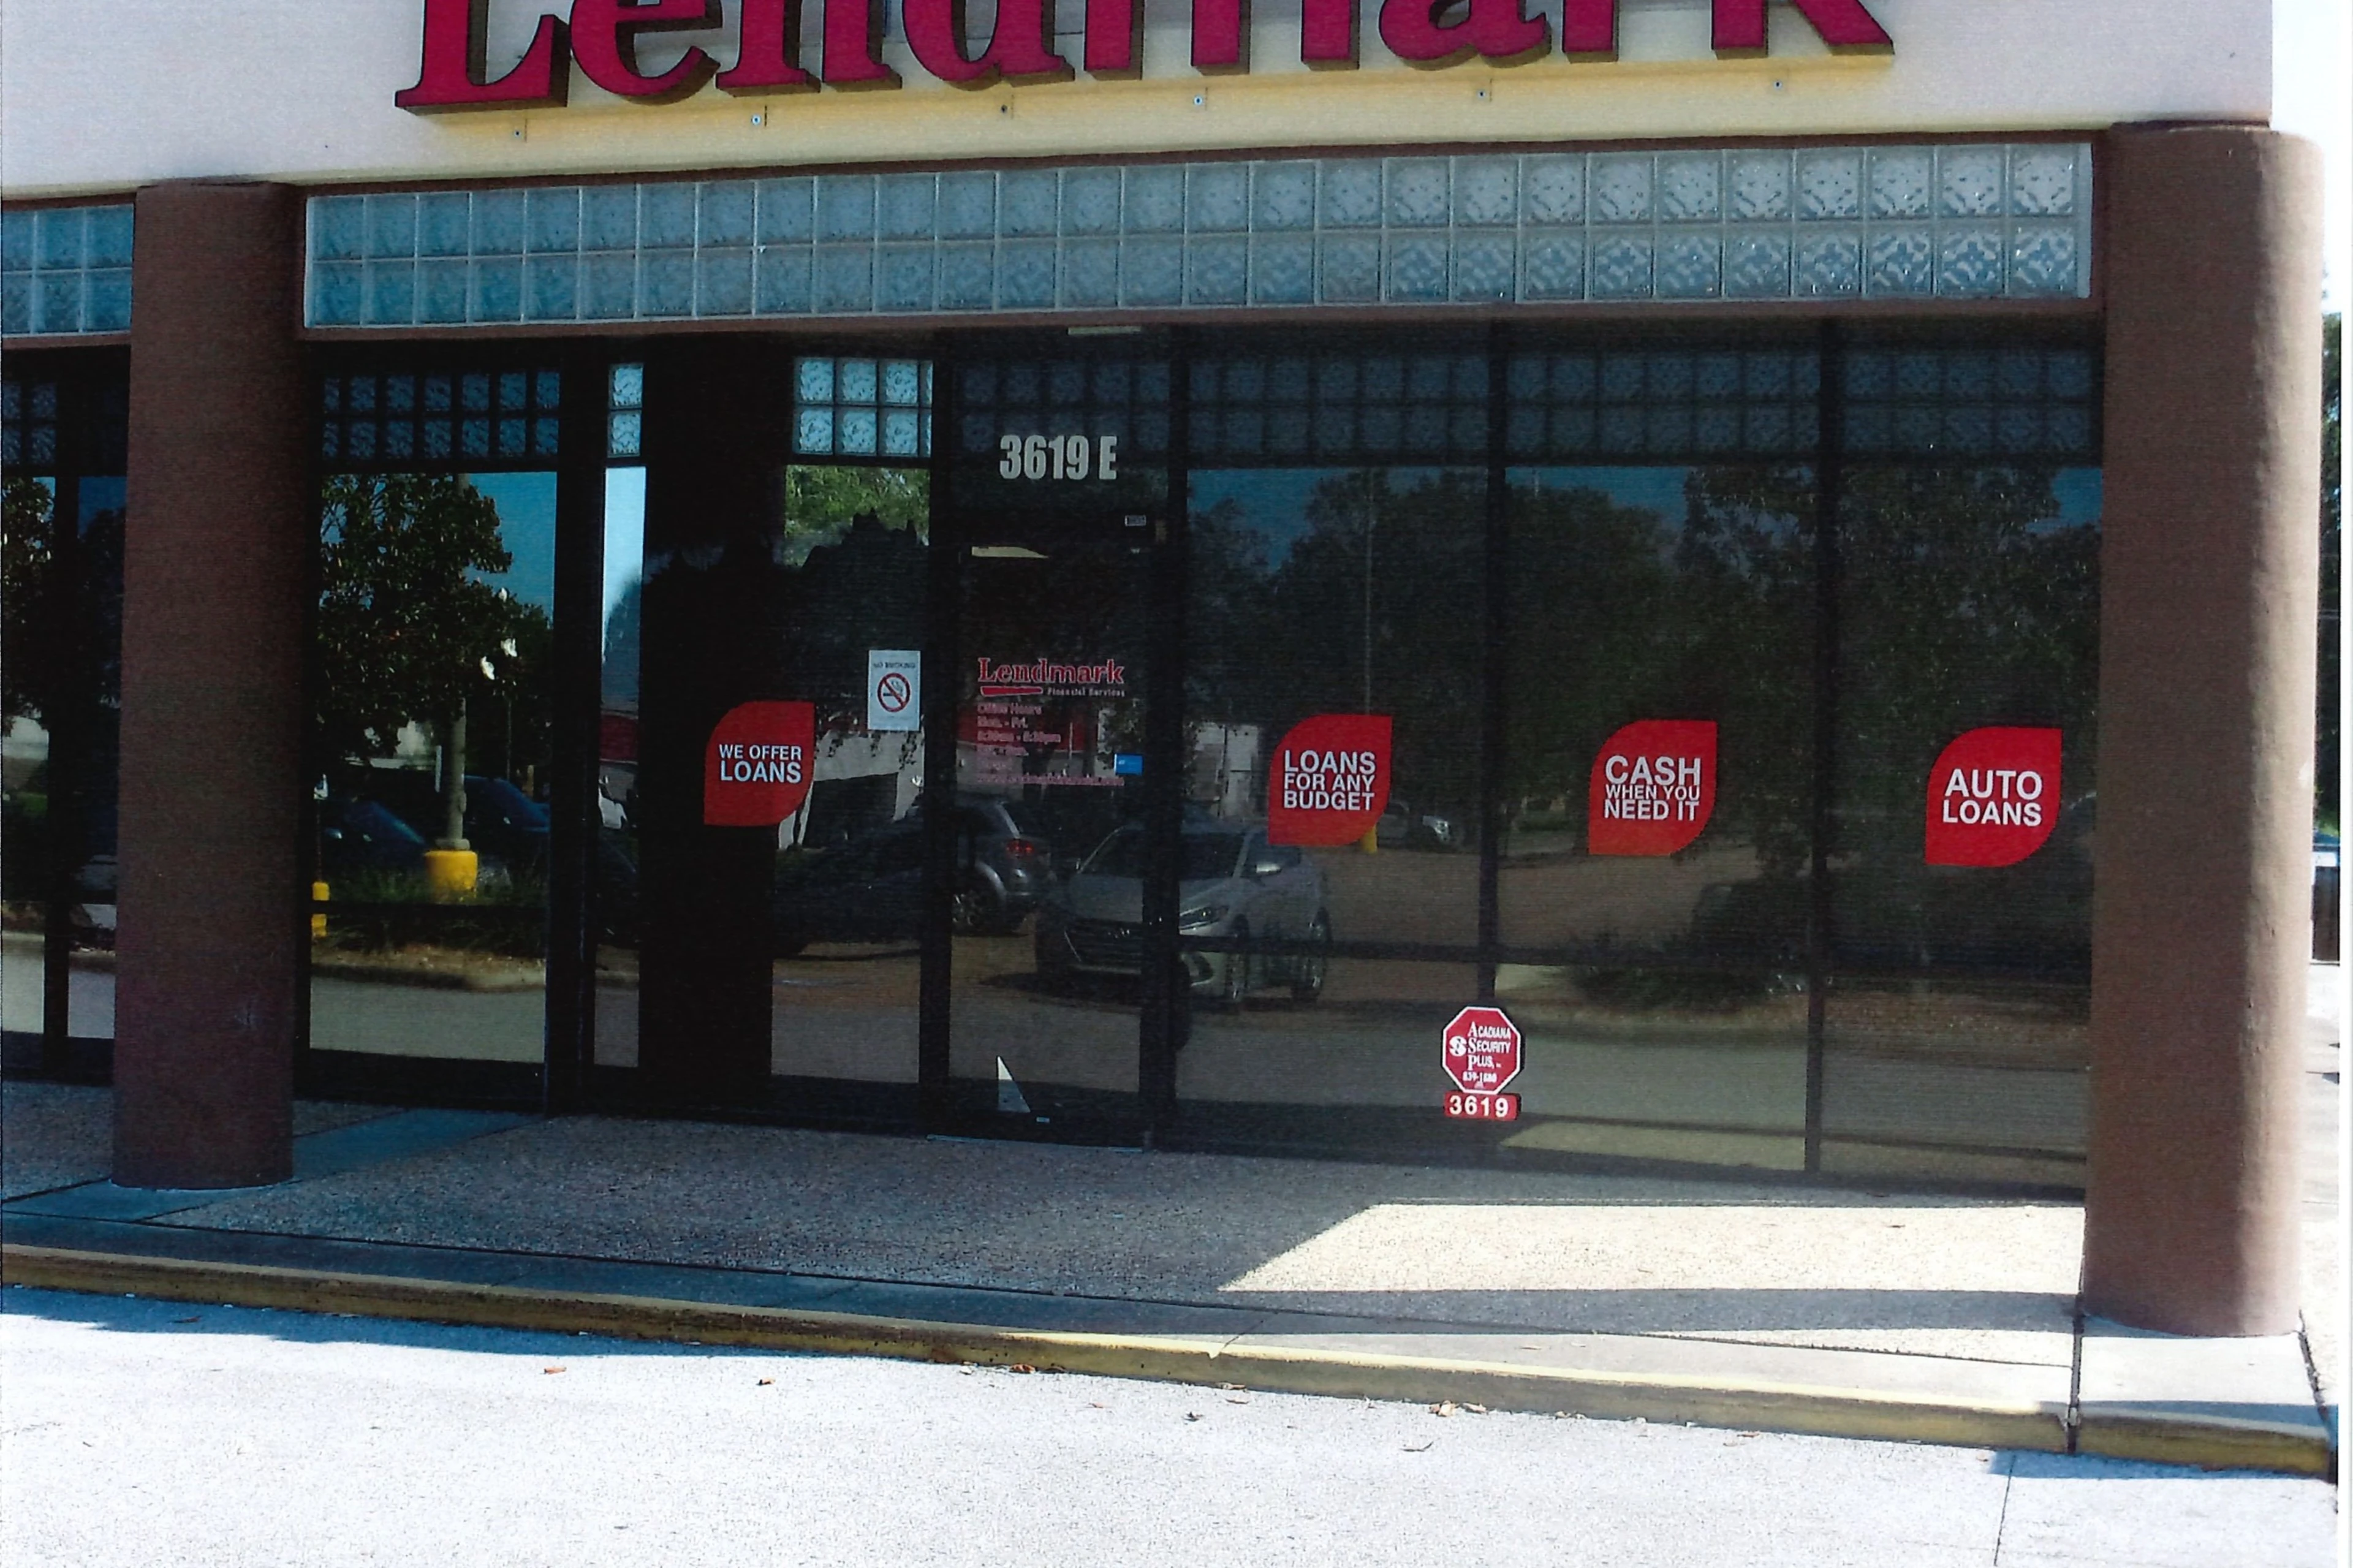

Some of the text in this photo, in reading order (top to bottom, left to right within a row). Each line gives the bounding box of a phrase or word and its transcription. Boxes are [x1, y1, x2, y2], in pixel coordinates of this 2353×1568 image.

[999, 434, 1117, 480] 3619 E
[978, 657, 1124, 684] Lendmark
[719, 744, 801, 760] WE OFFER
[1284, 749, 1376, 775] LOANS
[721, 760, 801, 784] LOANS
[1605, 755, 1701, 786] CASH
[1284, 773, 1375, 792] FOR ANY
[1605, 784, 1700, 801] WHEN YOU
[1944, 768, 2042, 800] AUTO
[1284, 790, 1375, 811] BUDGET
[1604, 799, 1700, 821] NEED IT
[1942, 800, 2042, 827] LOANS
[1468, 1037, 1511, 1053] SECURITY
[1449, 1096, 1509, 1117] 3619
